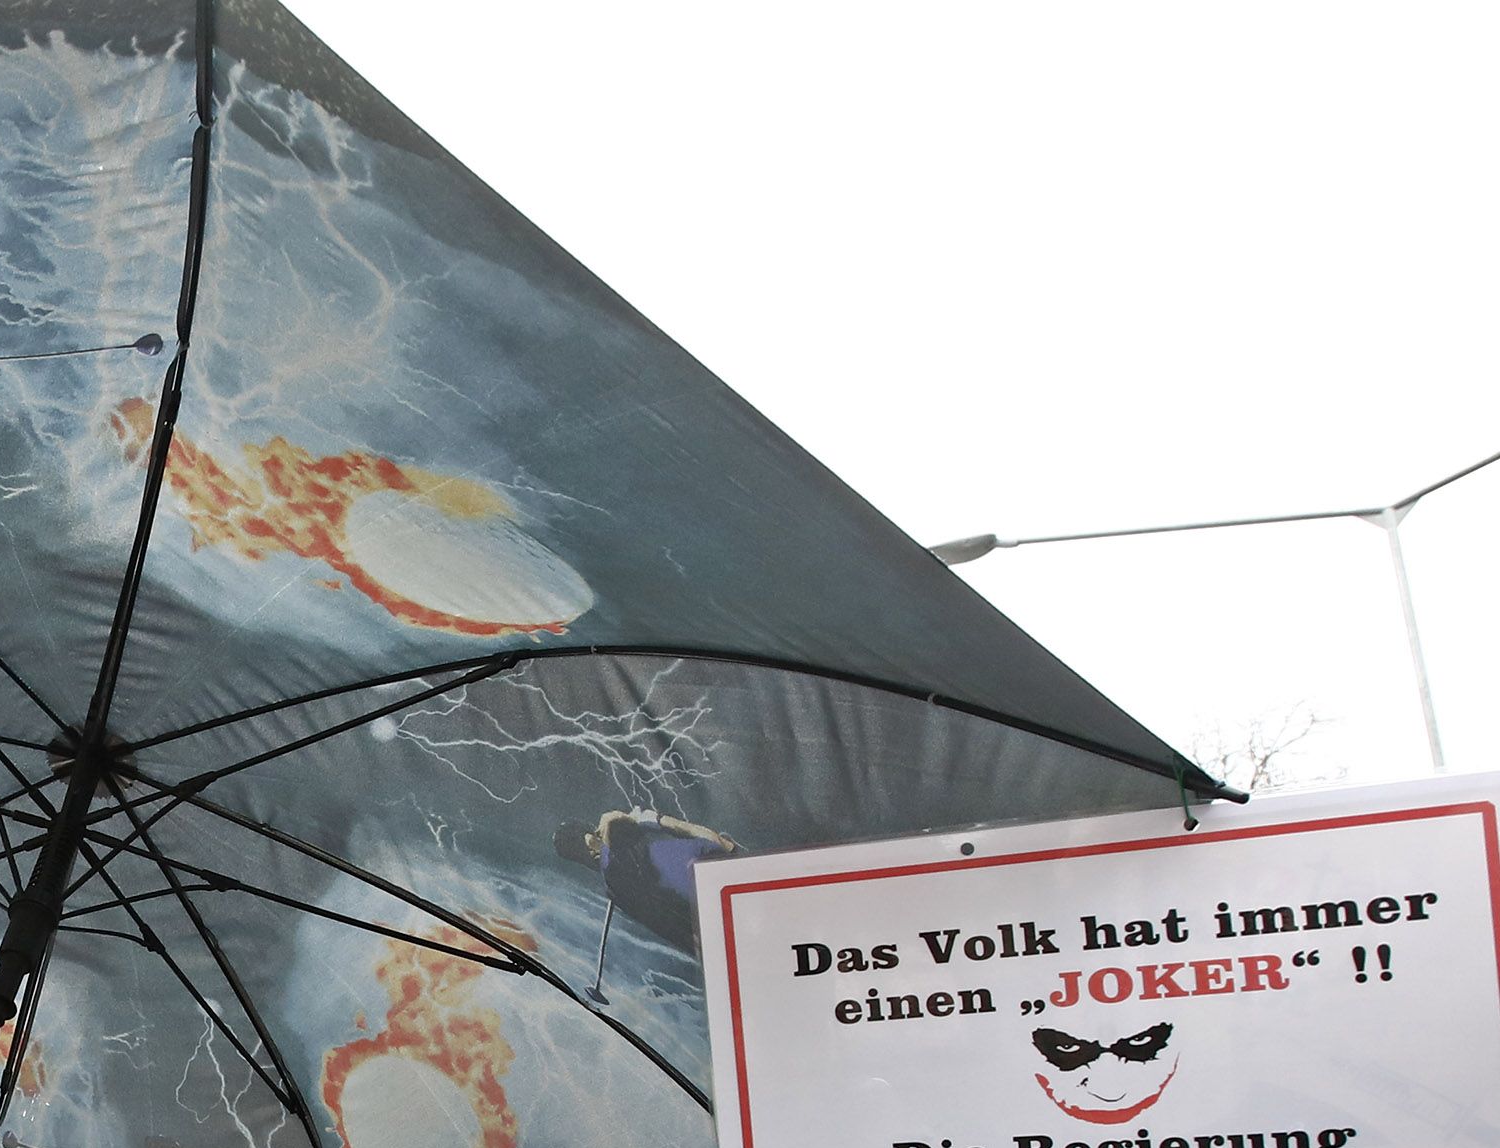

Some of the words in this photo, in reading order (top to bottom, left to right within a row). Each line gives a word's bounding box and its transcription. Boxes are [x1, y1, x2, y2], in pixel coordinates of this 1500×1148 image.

[791, 940, 900, 978] Das
[919, 920, 1060, 965] Volk
[1081, 907, 1190, 951] hat
[1214, 891, 1439, 940] immer
[834, 985, 998, 1026] einen
